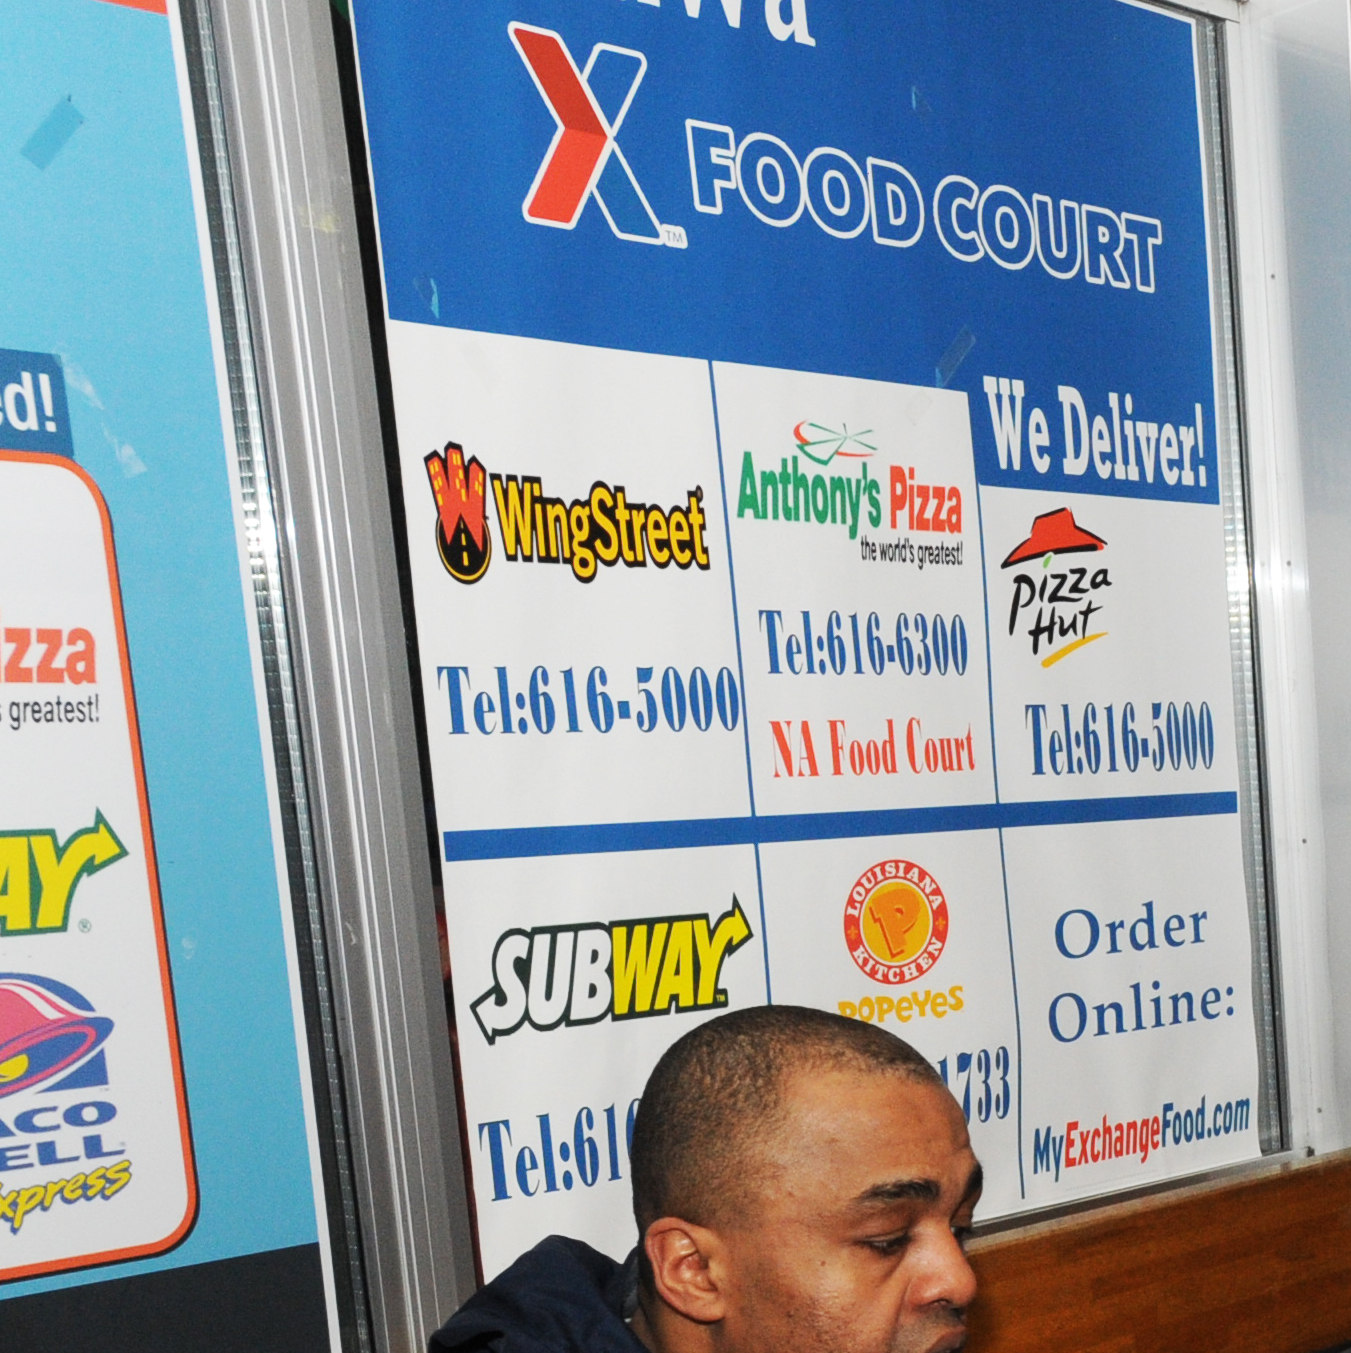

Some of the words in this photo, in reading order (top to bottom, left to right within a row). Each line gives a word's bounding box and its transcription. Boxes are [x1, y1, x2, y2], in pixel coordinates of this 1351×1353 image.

[685, 118, 925, 247] FOOD
[934, 174, 1162, 293] COURT
[0, 371, 57, 433] d!
[983, 374, 1048, 475] We
[1058, 384, 1206, 487] Deliver!
[489, 473, 711, 583] WingStreet
[737, 451, 881, 539] Anthony's
[889, 465, 963, 533] Pizza
[860, 535, 878, 562] the
[879, 536, 915, 566] world's
[917, 539, 964, 570] greatest!
[757, 609, 969, 679] Tel:616-6300
[1032, 606, 1104, 655] Hut
[10, 694, 100, 731] greatest!
[437, 665, 740, 736] Tel:616-5000
[768, 719, 819, 778] NA
[830, 717, 897, 776] Food
[907, 716, 976, 774] Court
[1024, 701, 1215, 777] Tel:616-5000
[847, 862, 941, 917] LOUISIANA
[853, 936, 943, 982] KITCHEN
[1055, 901, 1208, 960] Order
[470, 892, 754, 1045] SUBWAY
[1049, 982, 1236, 1043] Online:
[1034, 1095, 1250, 1183] MyExchangeFood.com
